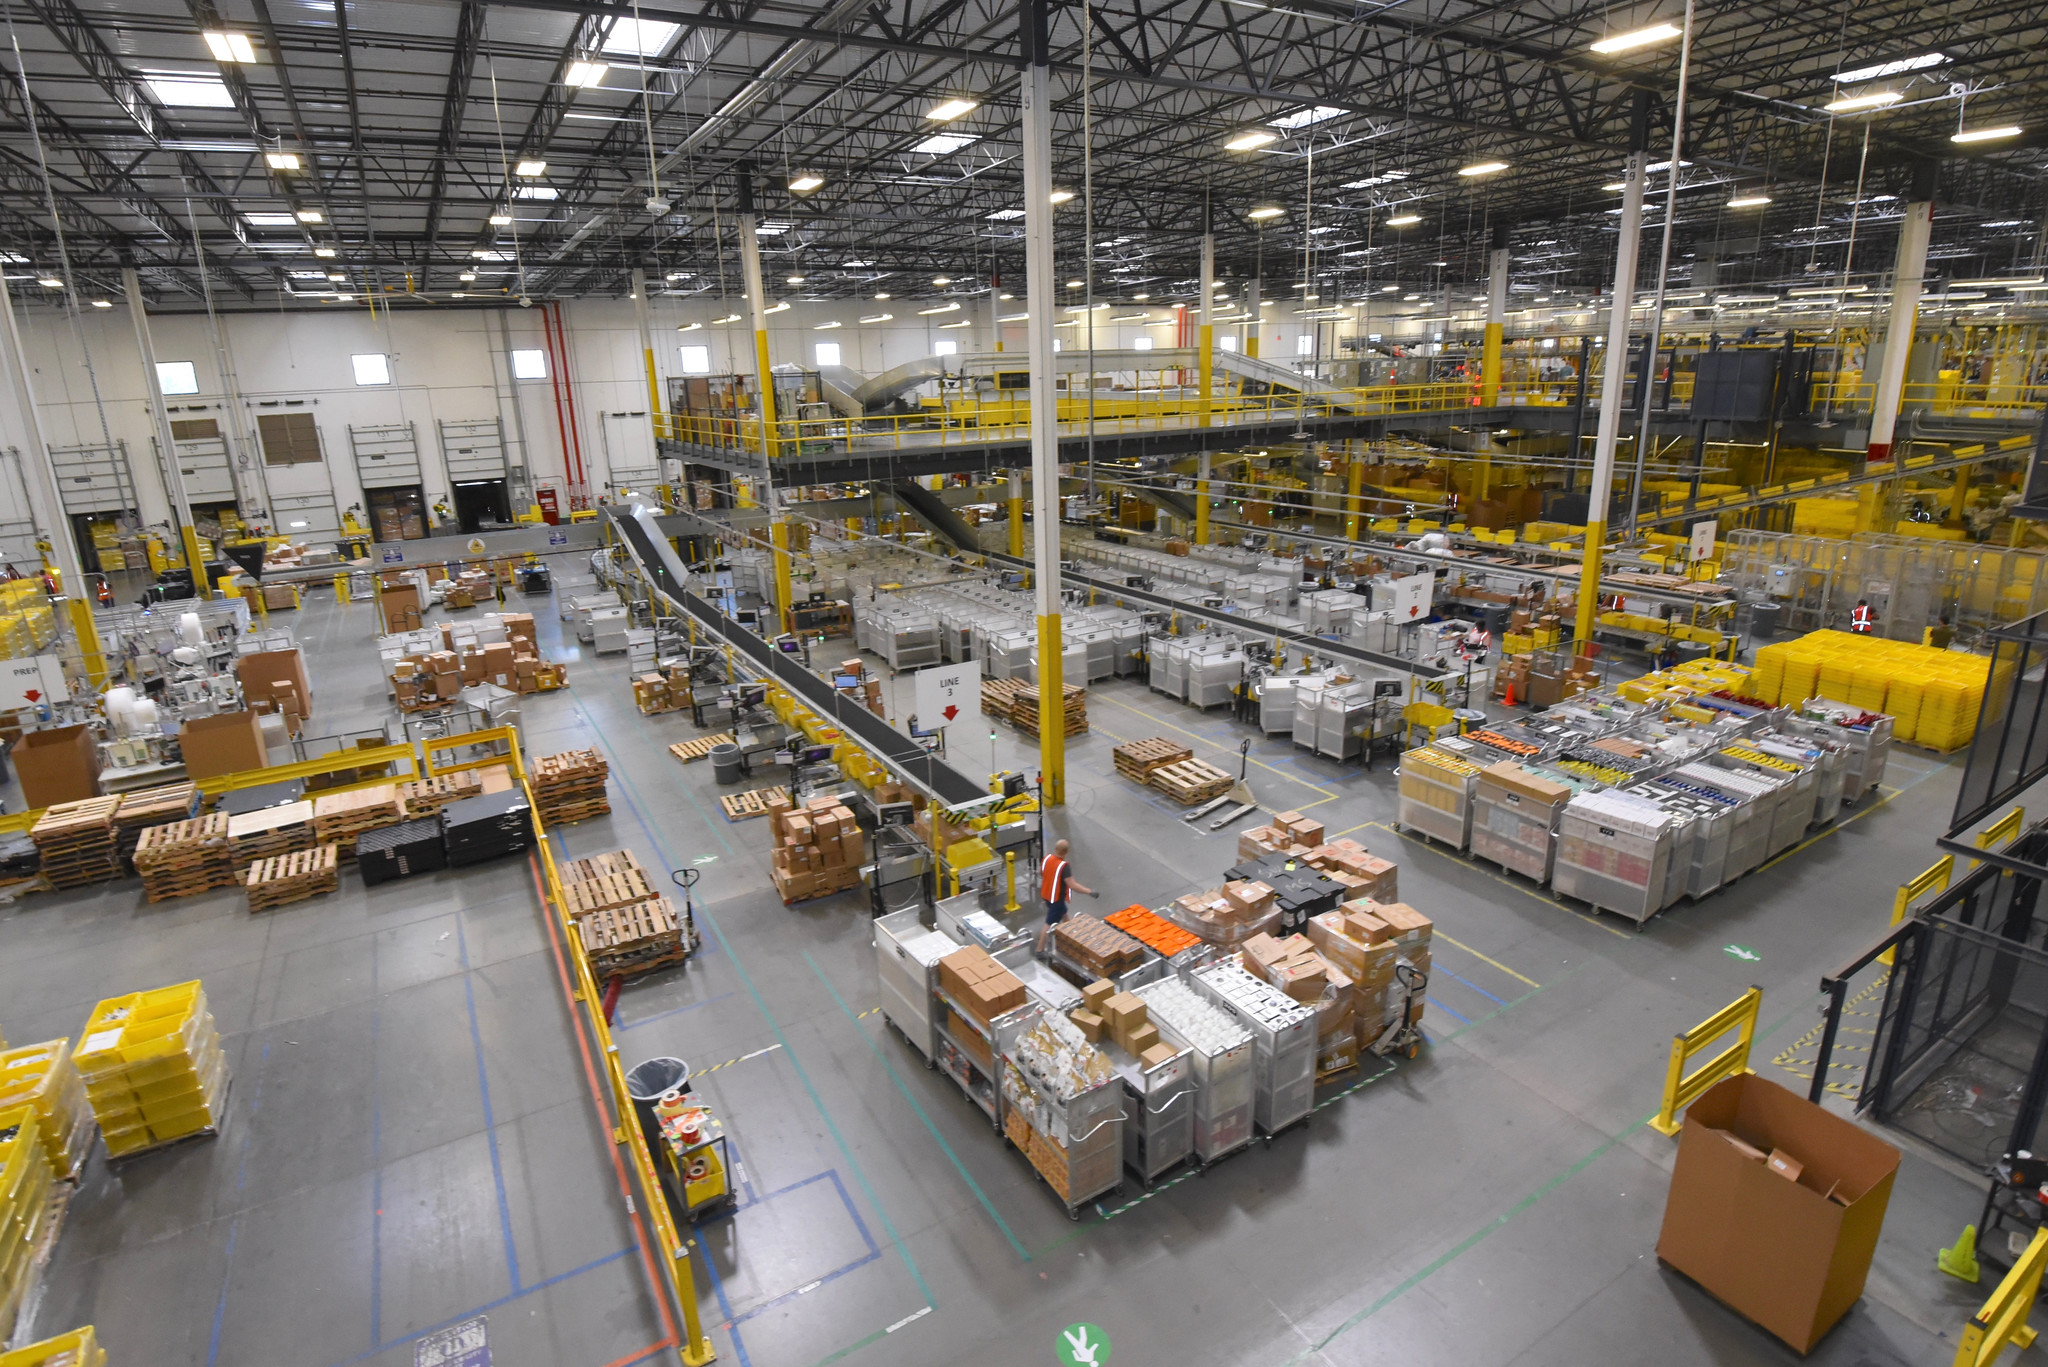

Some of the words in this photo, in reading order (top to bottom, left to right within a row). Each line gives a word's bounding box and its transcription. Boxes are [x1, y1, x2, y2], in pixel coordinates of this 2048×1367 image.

[1024, 95, 1031, 110] 9
[1630, 159, 1637, 170] G
[1629, 171, 1636, 182] 9
[13, 666, 38, 676] PREP
[940, 676, 960, 688] LINE
[947, 687, 953, 697] 3
